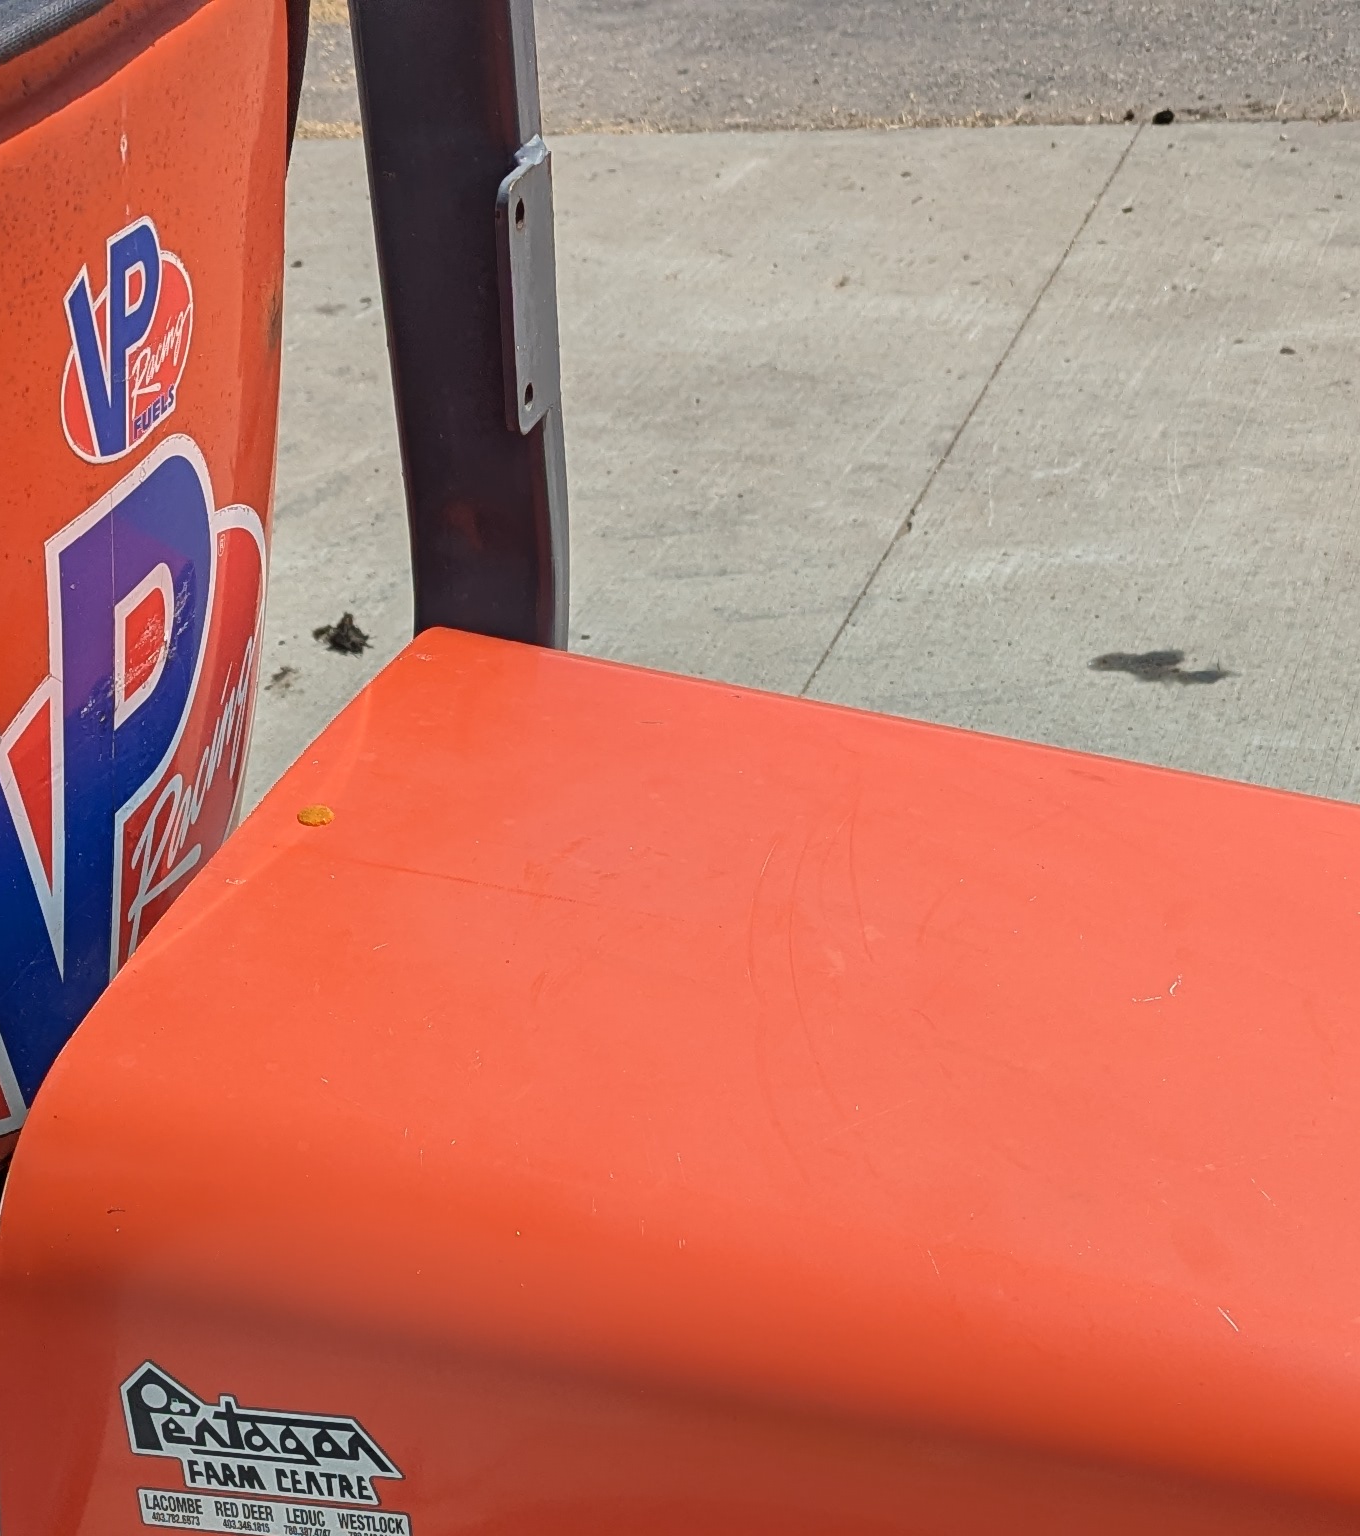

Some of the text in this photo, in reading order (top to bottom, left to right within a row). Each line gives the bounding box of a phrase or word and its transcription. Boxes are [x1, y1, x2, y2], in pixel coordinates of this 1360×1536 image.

[64, 216, 162, 458] VP
[130, 303, 193, 420] Racing
[133, 383, 175, 441] FUELS
[125, 1366, 395, 1475] Pentagon
[143, 1493, 405, 1536] LACOMBE RED DEER LEDUC WESTLOCK
[186, 1458, 375, 1501] FARM CENTRE
